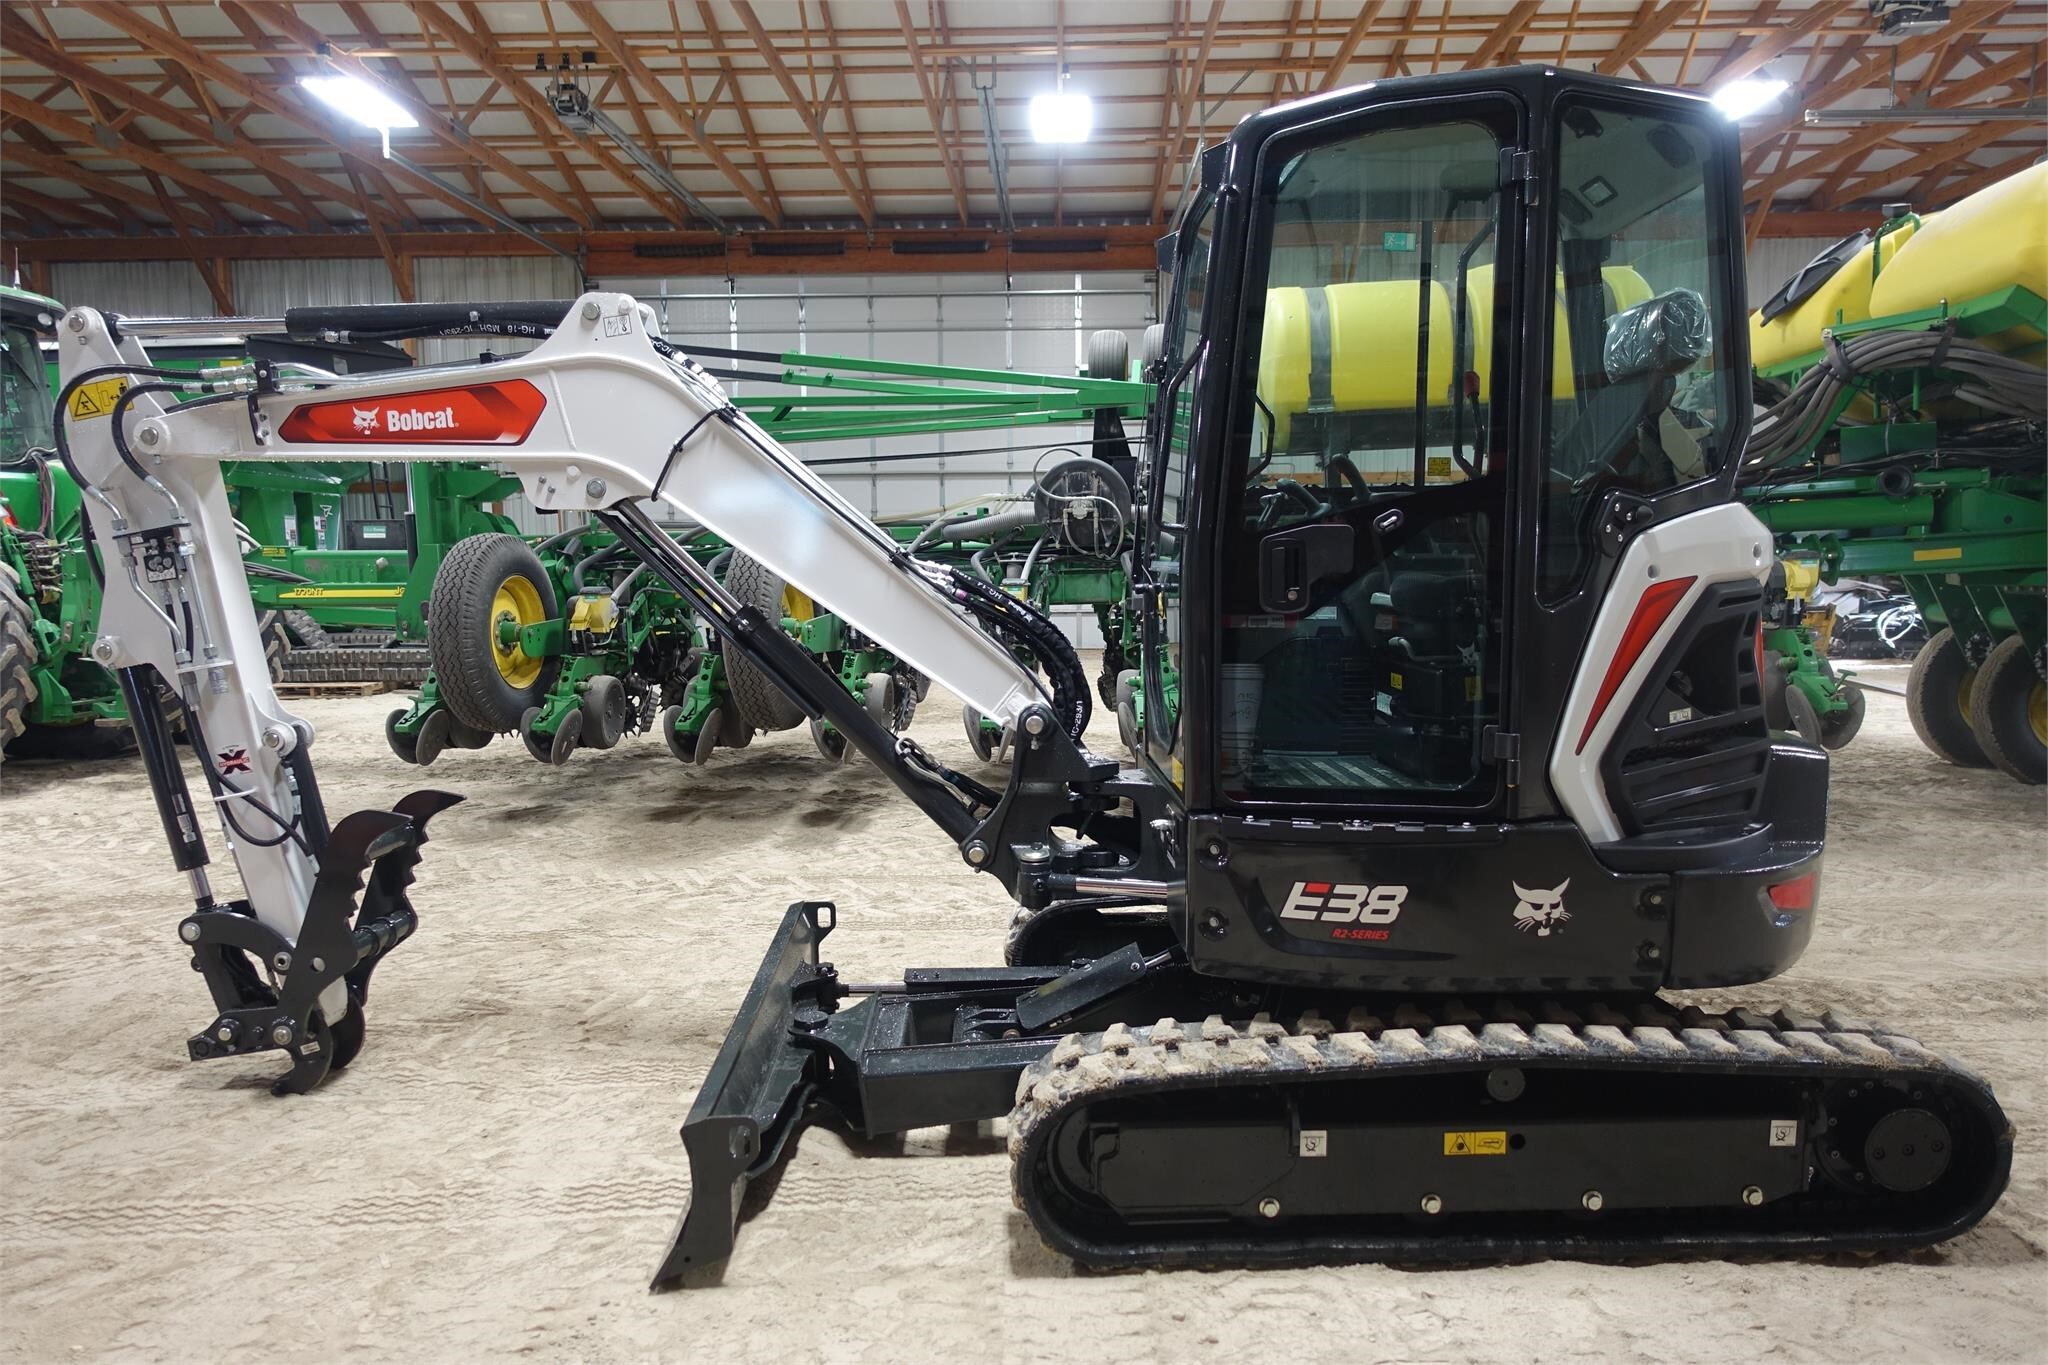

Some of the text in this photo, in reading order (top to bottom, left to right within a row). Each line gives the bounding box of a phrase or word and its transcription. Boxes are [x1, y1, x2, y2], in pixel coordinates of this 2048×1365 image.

[386, 407, 454, 432] Bobcat
[1280, 881, 1409, 924] E38
[1332, 928, 1390, 940] R2-SERIES
